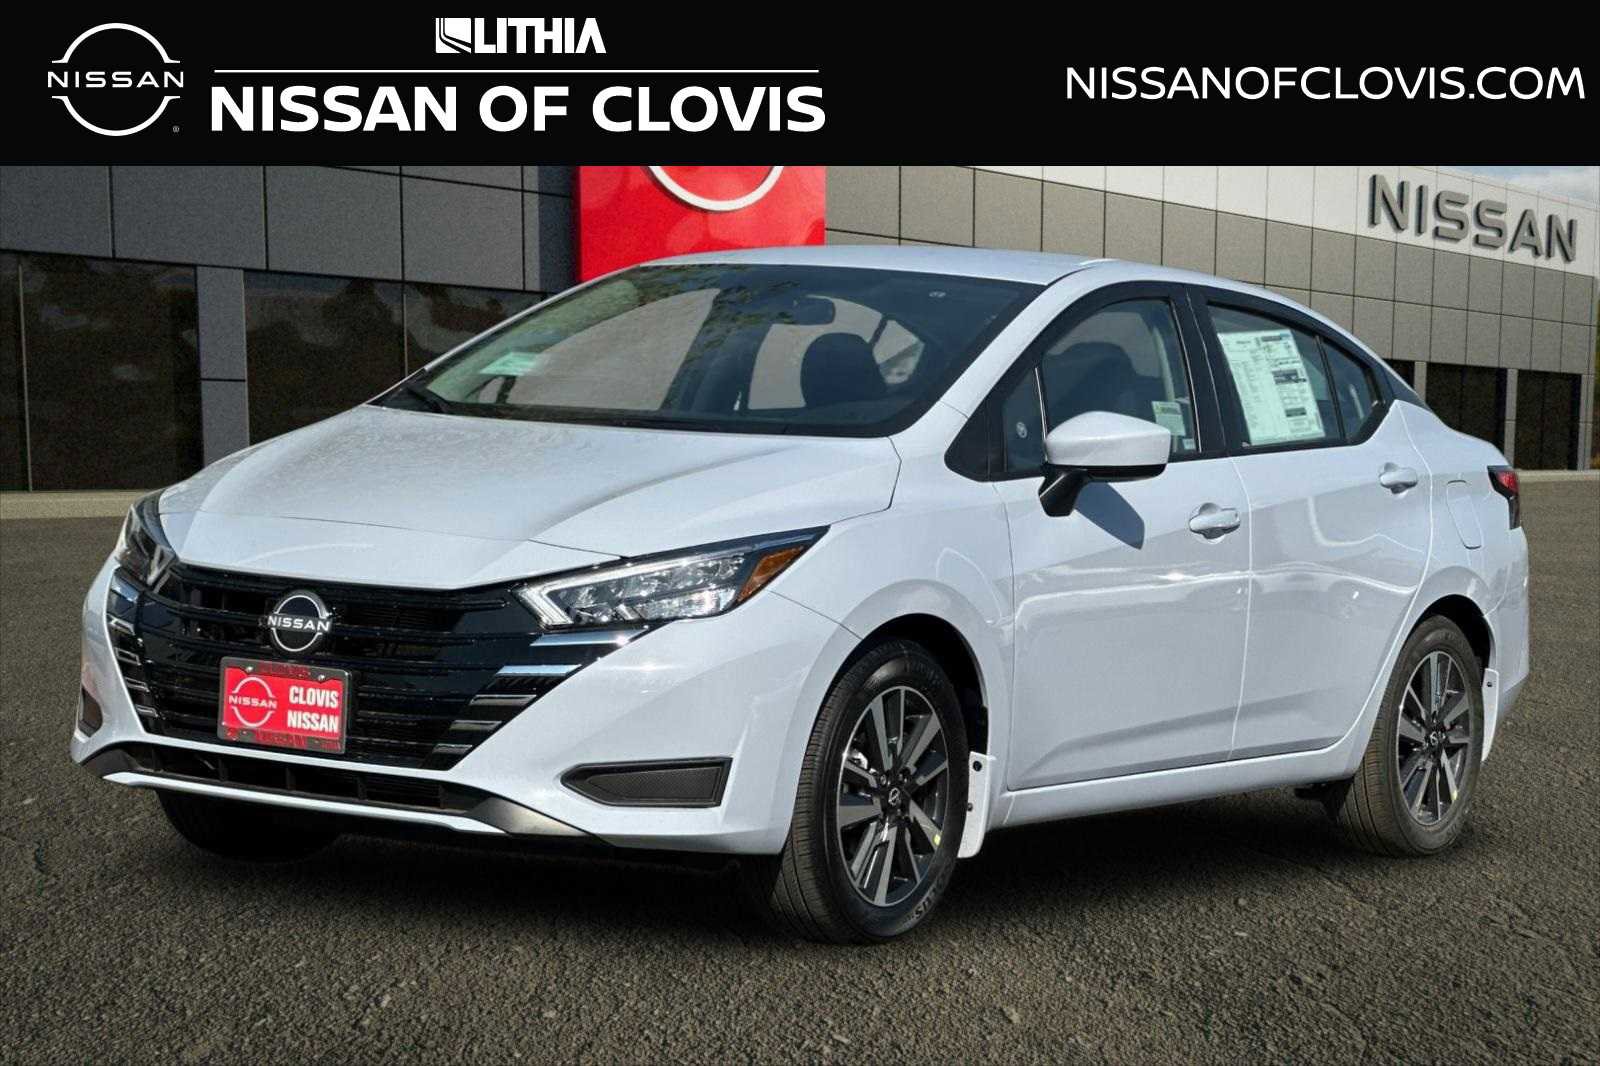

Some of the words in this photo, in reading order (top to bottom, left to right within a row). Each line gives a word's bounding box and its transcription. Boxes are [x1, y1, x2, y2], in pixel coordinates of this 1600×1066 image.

[1368, 174, 1578, 263] NISSAN
[267, 615, 331, 632] NISSAN
[228, 695, 278, 709] NISSAN
[289, 685, 339, 709] CLOVIS
[287, 710, 339, 733] NISSAN
